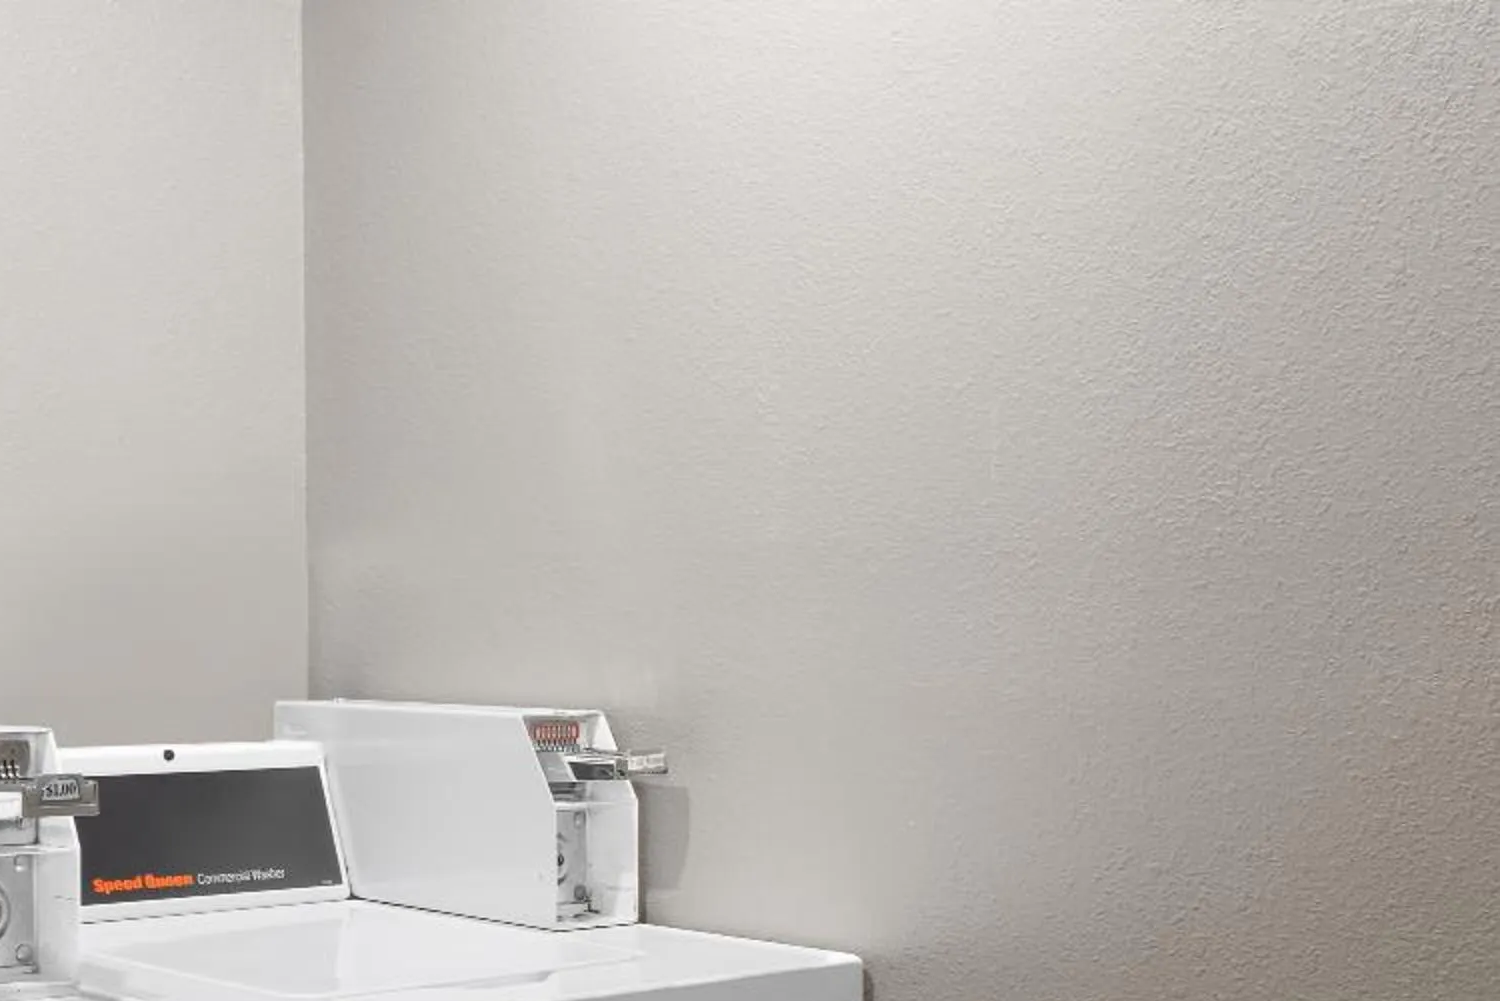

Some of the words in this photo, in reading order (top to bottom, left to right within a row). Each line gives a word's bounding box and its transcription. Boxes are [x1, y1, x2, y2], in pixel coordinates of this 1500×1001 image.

[92, 877, 143, 894] Speed
[144, 871, 195, 889] Queen
[197, 870, 250, 885] Commercial
[251, 867, 286, 881] Washer
